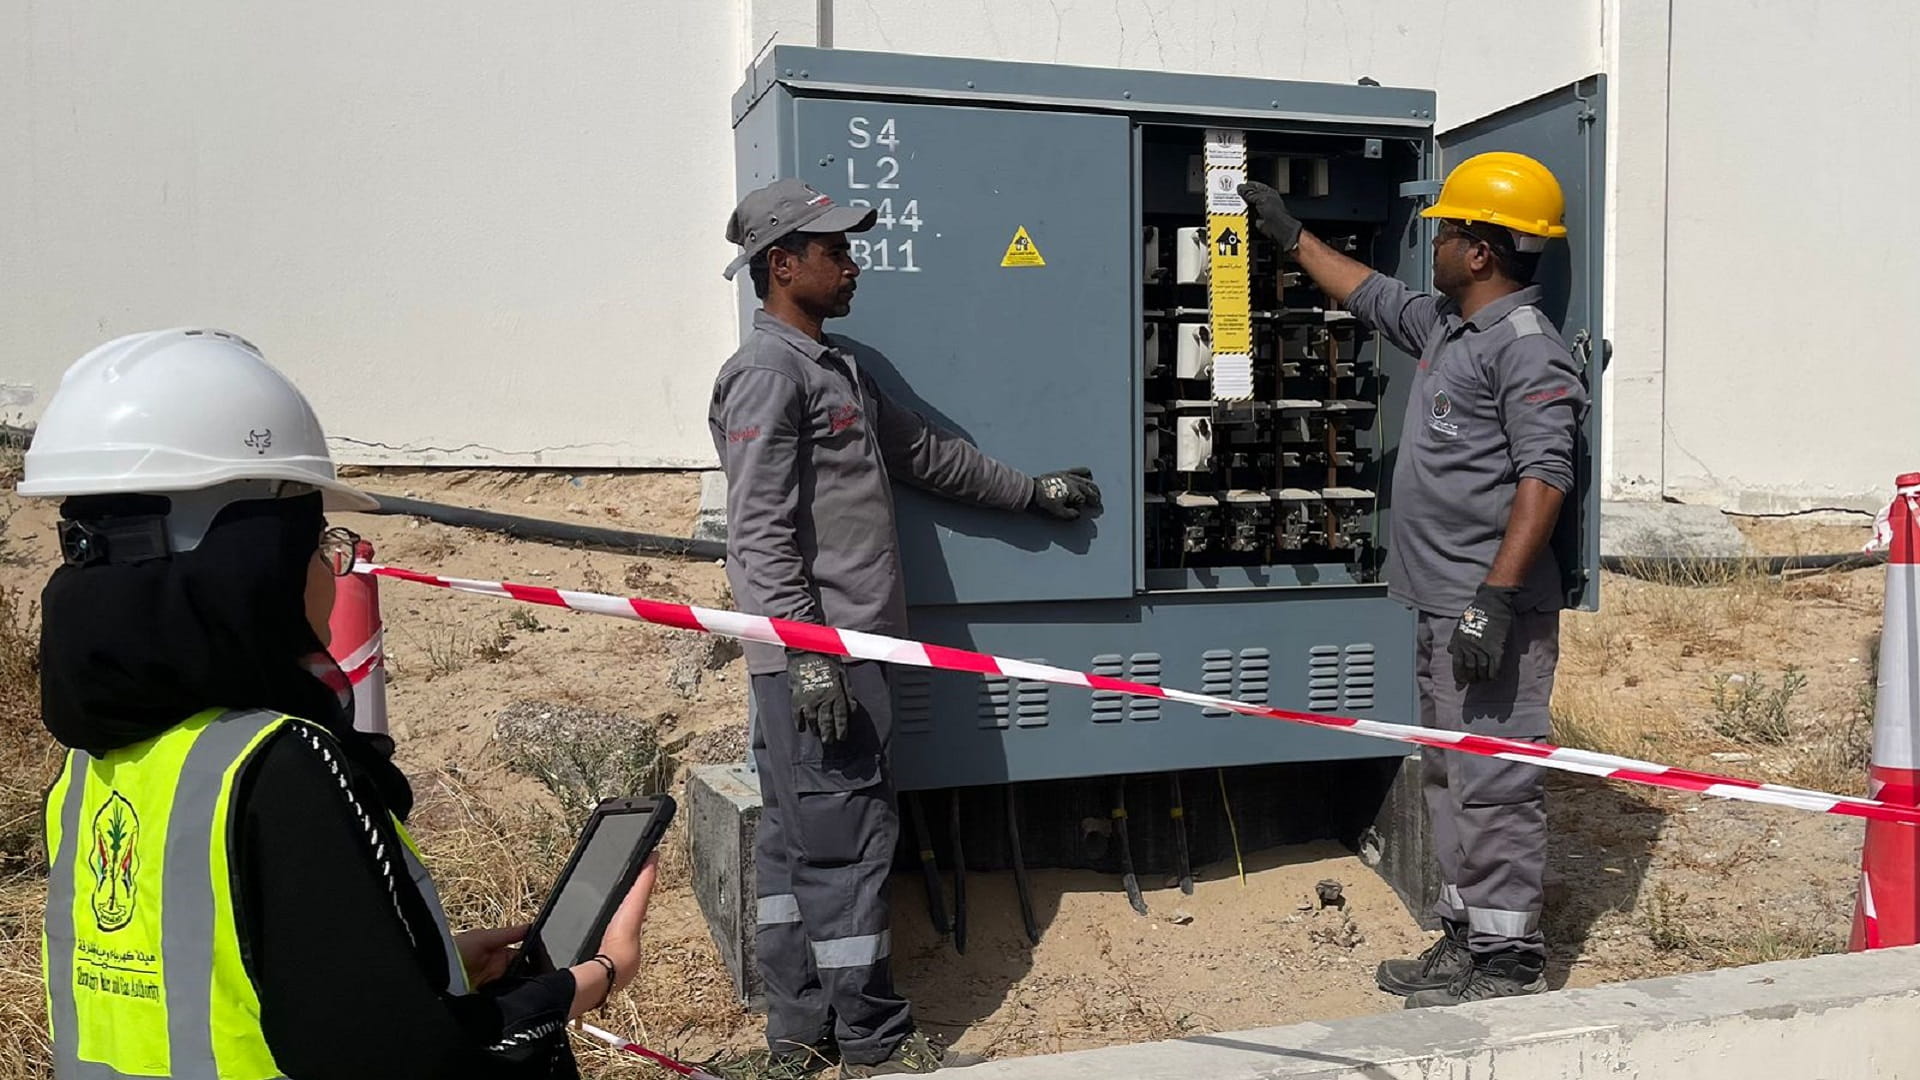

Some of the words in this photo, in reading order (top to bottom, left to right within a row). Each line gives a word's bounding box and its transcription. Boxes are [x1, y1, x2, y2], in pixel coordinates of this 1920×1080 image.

[848, 117, 899, 151] S4
[847, 156, 900, 190] L2
[850, 198, 923, 232] 44
[850, 238, 922, 272] B11
